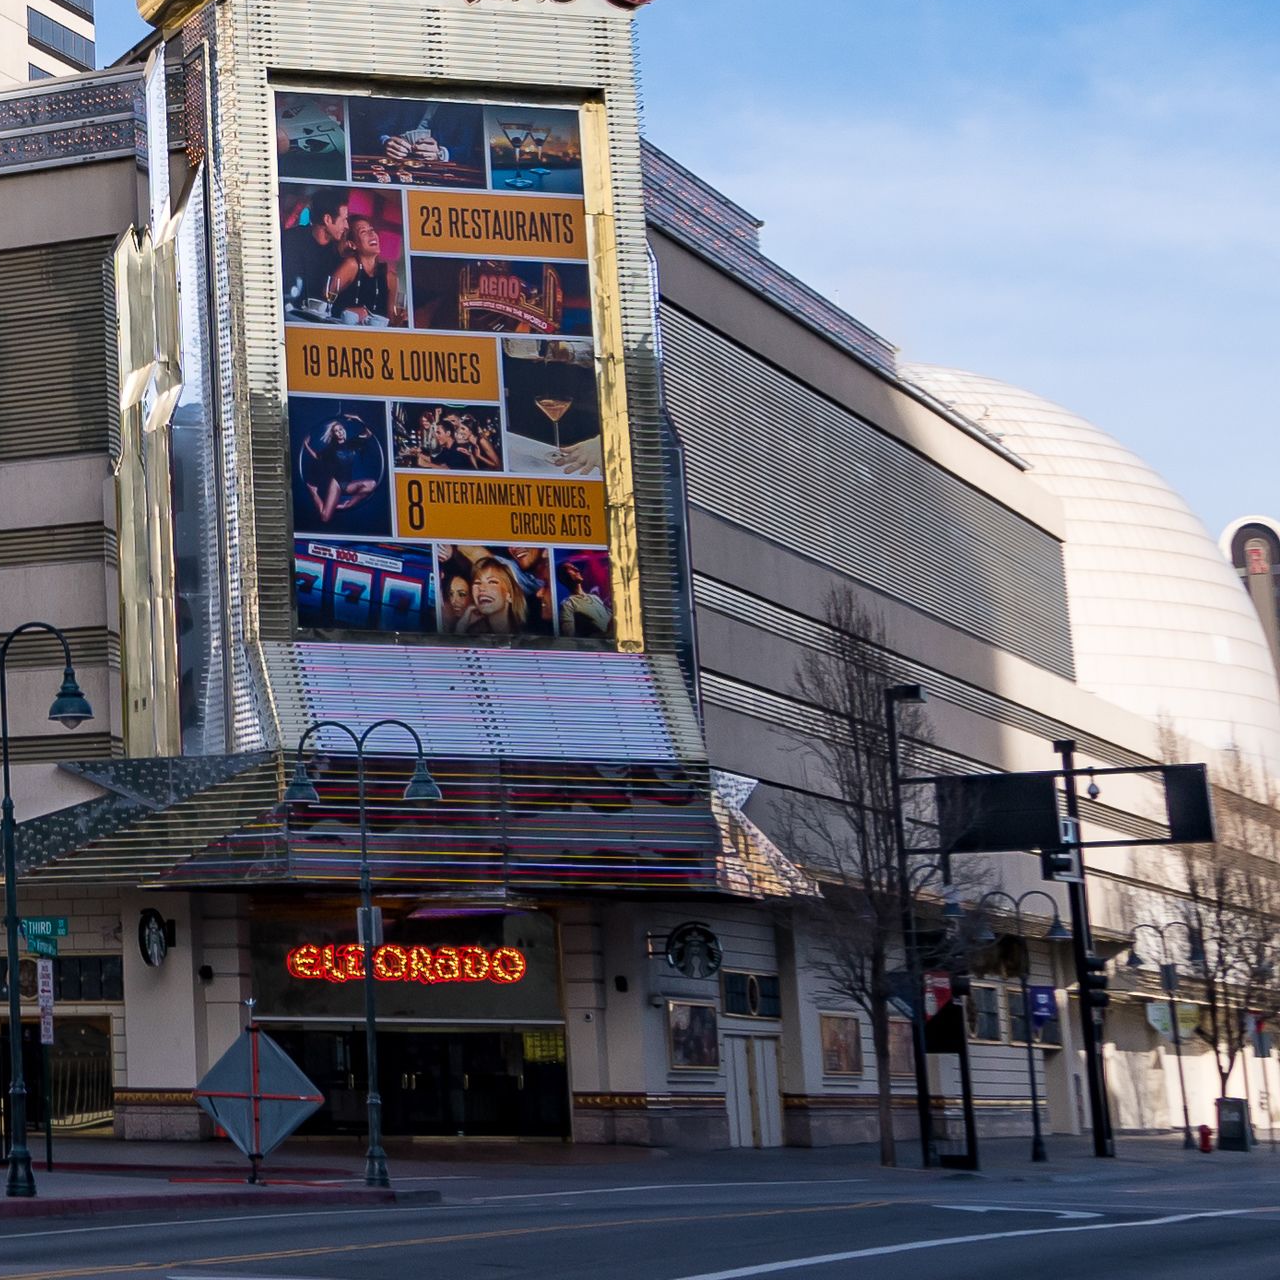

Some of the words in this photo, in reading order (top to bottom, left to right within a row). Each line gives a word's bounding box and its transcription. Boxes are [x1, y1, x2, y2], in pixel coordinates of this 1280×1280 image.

[419, 205, 443, 238] 23
[448, 207, 575, 244] RESTAURANTS
[523, 312, 548, 329] WORLD
[302, 344, 321, 377] 19
[327, 345, 374, 380] BARS
[381, 348, 394, 380] &
[400, 349, 481, 385] LOUNGES
[407, 479, 425, 531] 8
[429, 480, 532, 507] ENTERTAINMENT
[510, 511, 556, 536] CIRCUS
[560, 512, 592, 537] ACTS
[29, 921, 51, 935] THIRD
